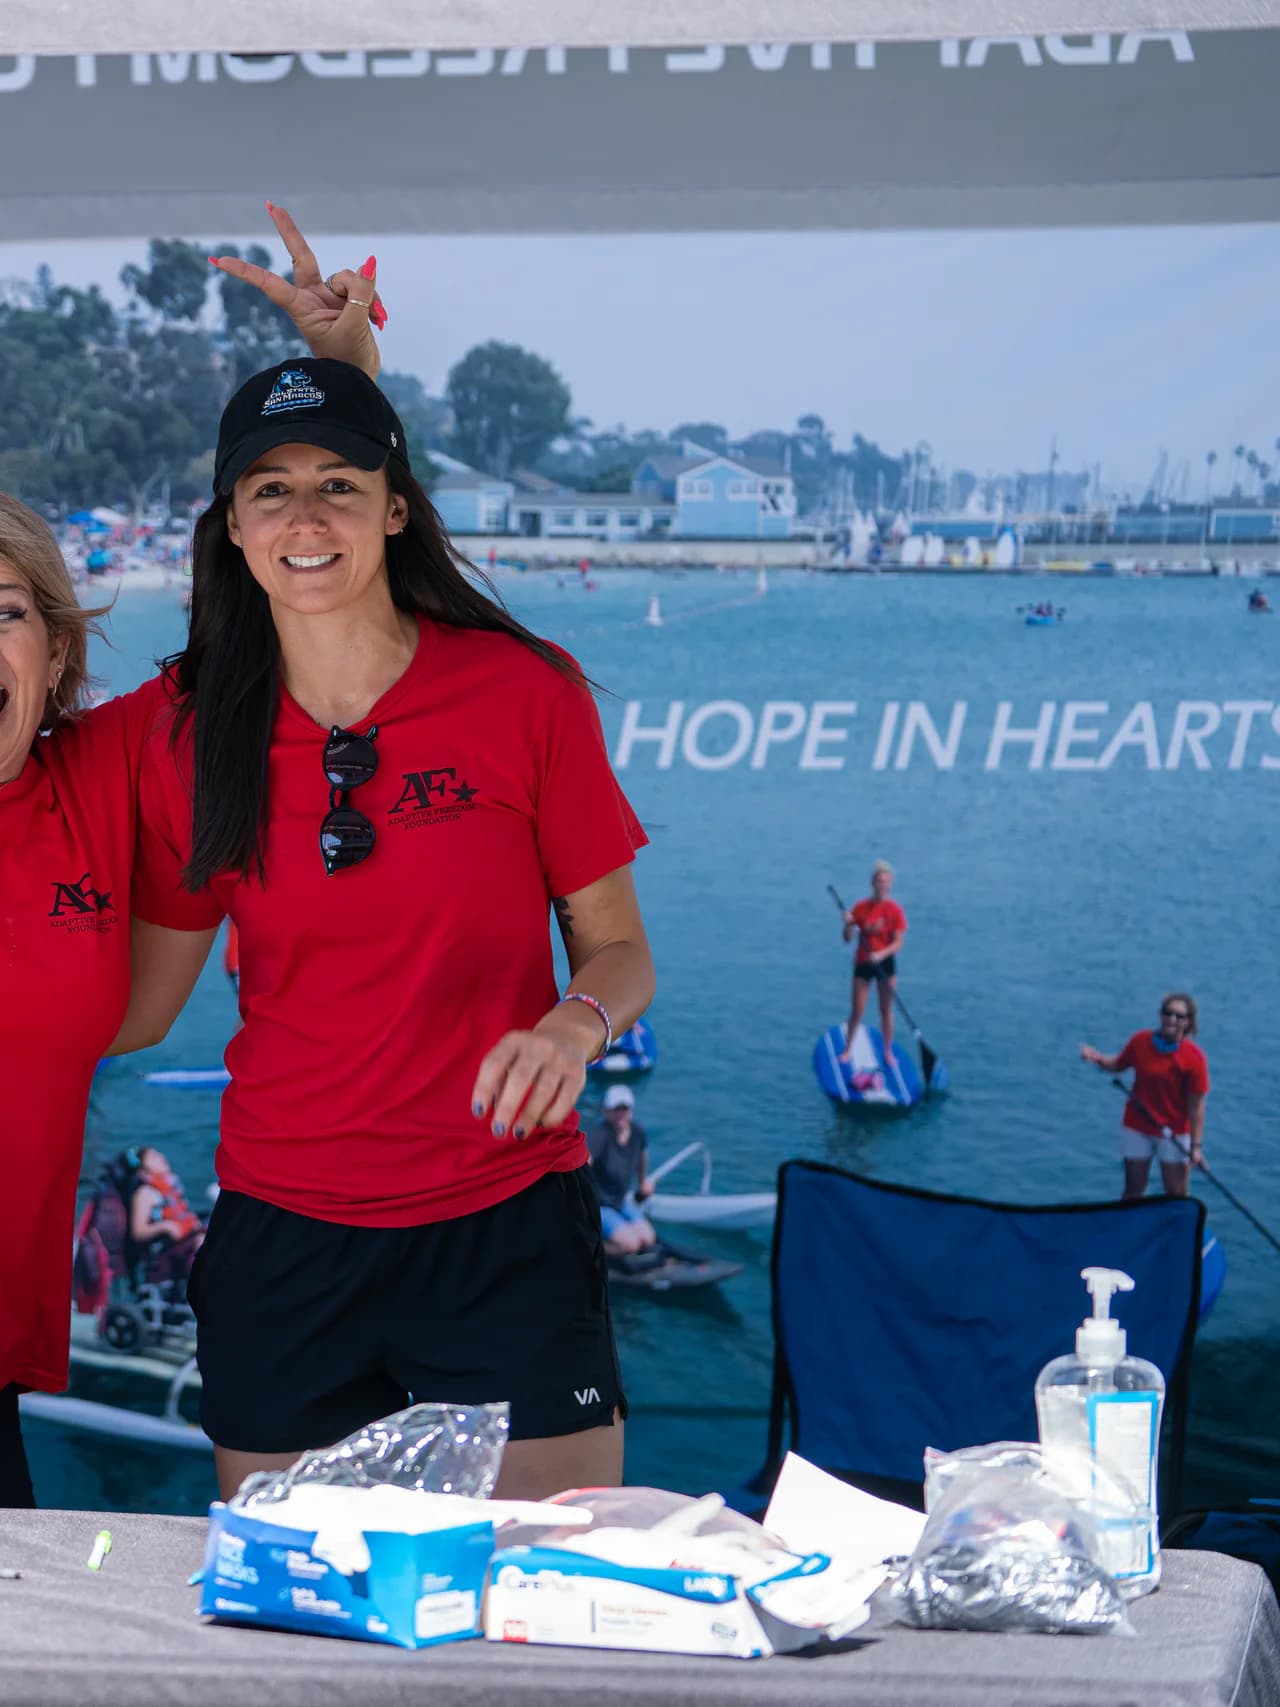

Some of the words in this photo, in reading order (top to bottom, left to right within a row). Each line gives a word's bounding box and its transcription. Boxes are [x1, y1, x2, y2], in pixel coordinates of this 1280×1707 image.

[614, 700, 857, 771] HOPE
[872, 700, 968, 771] IN
[388, 767, 457, 814] AF
[387, 810, 432, 827] ADAPTIVE
[404, 813, 462, 831] FOUNDATION
